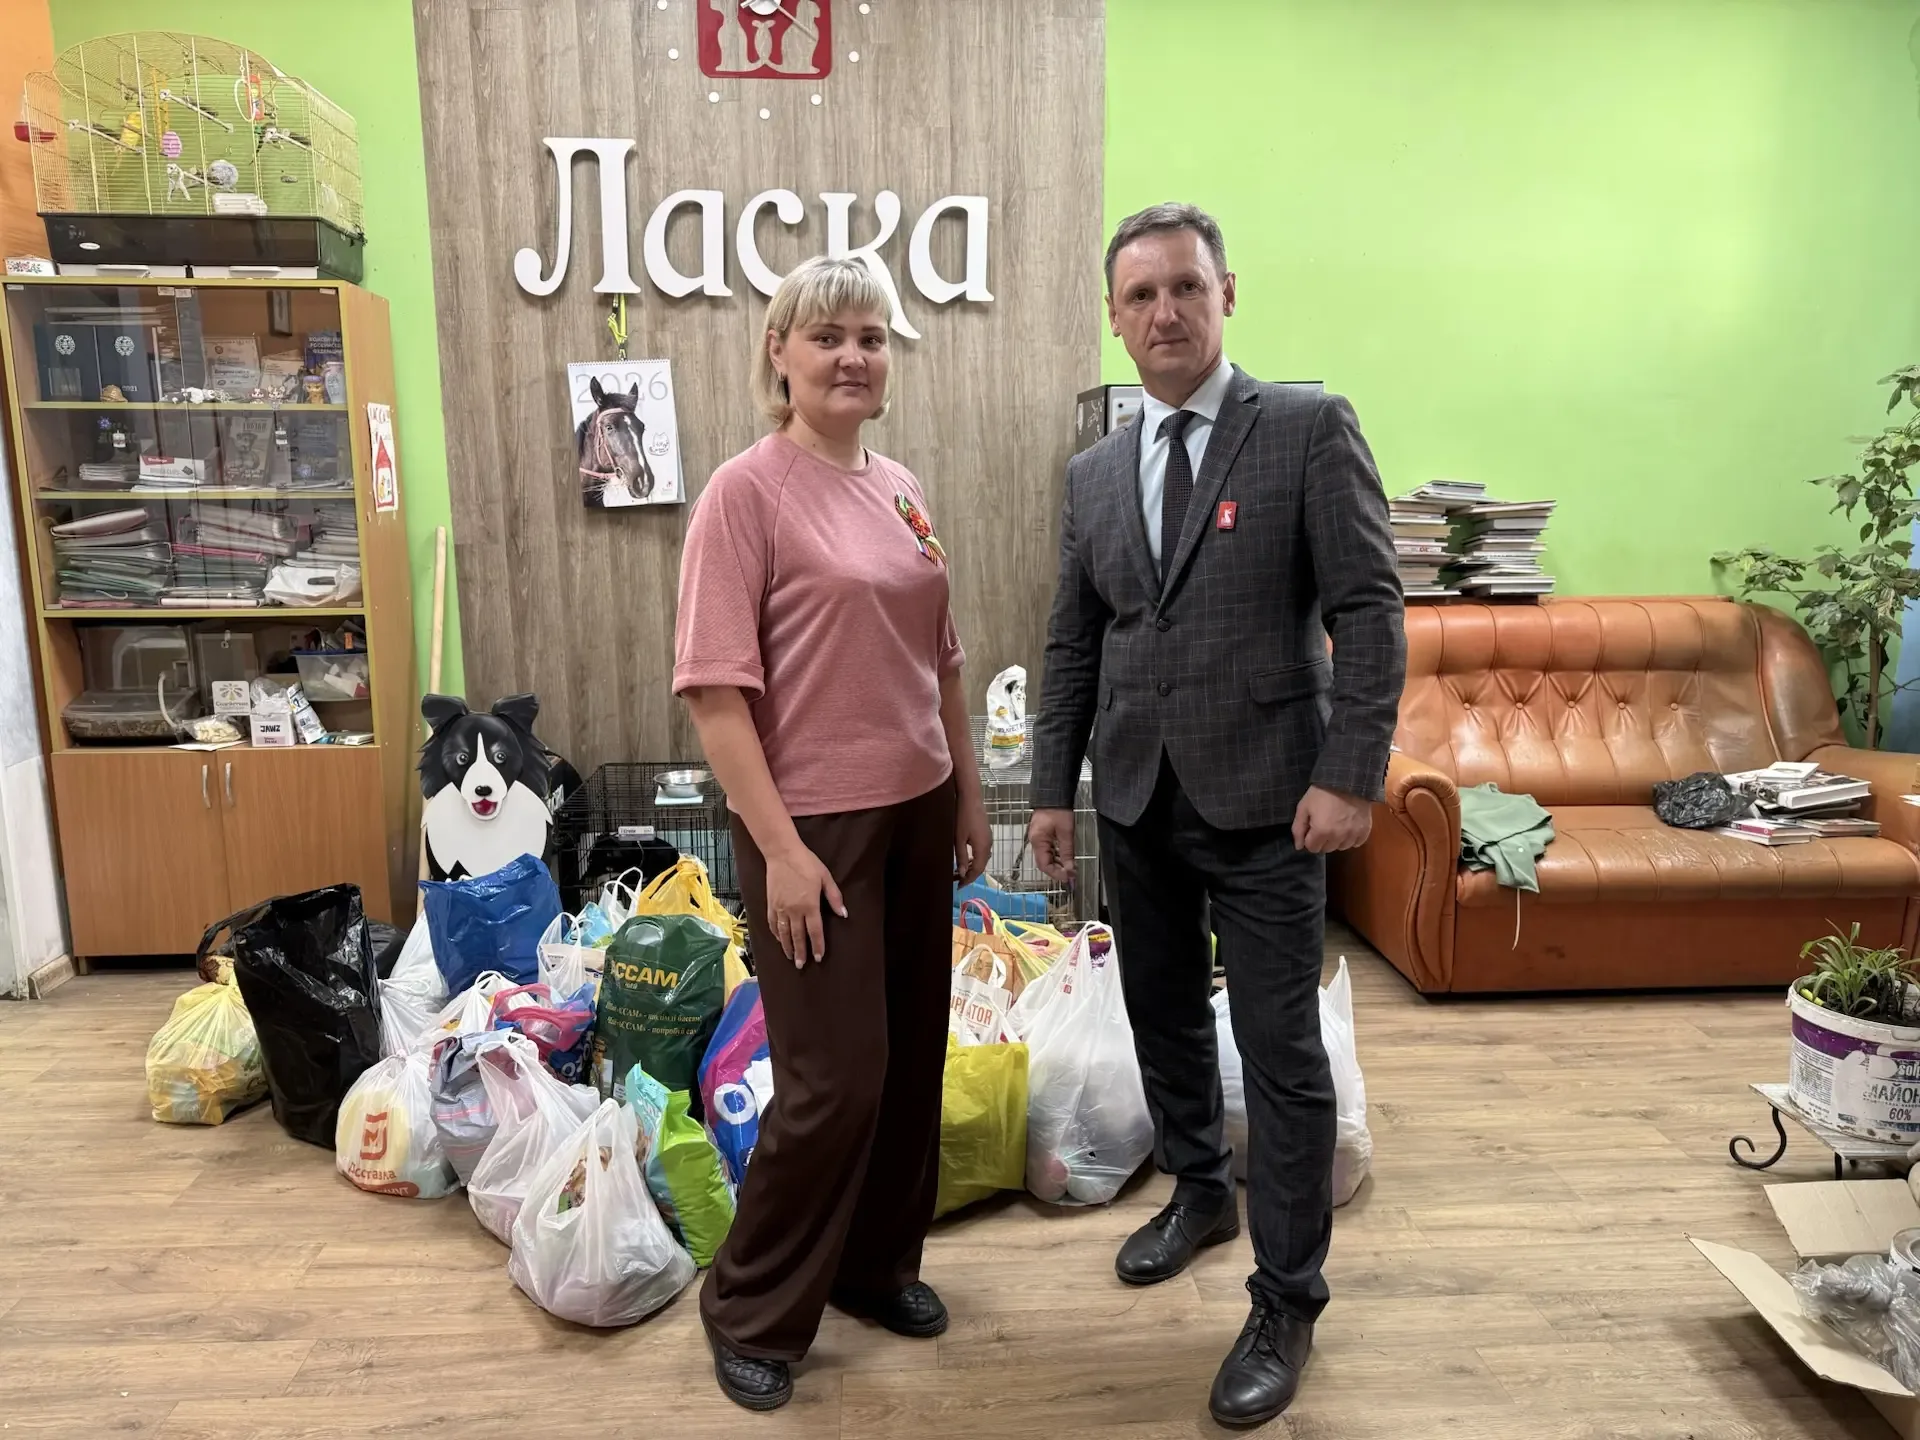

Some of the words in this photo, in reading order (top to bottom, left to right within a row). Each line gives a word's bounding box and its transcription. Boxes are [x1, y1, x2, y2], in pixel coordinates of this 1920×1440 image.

[514, 136, 994, 340] Ласка
[575, 371, 669, 404] 2026
[260, 724, 281, 733] JAWZ
[1889, 1107, 1912, 1121] 60%
[348, 1161, 397, 1181] Доставка
